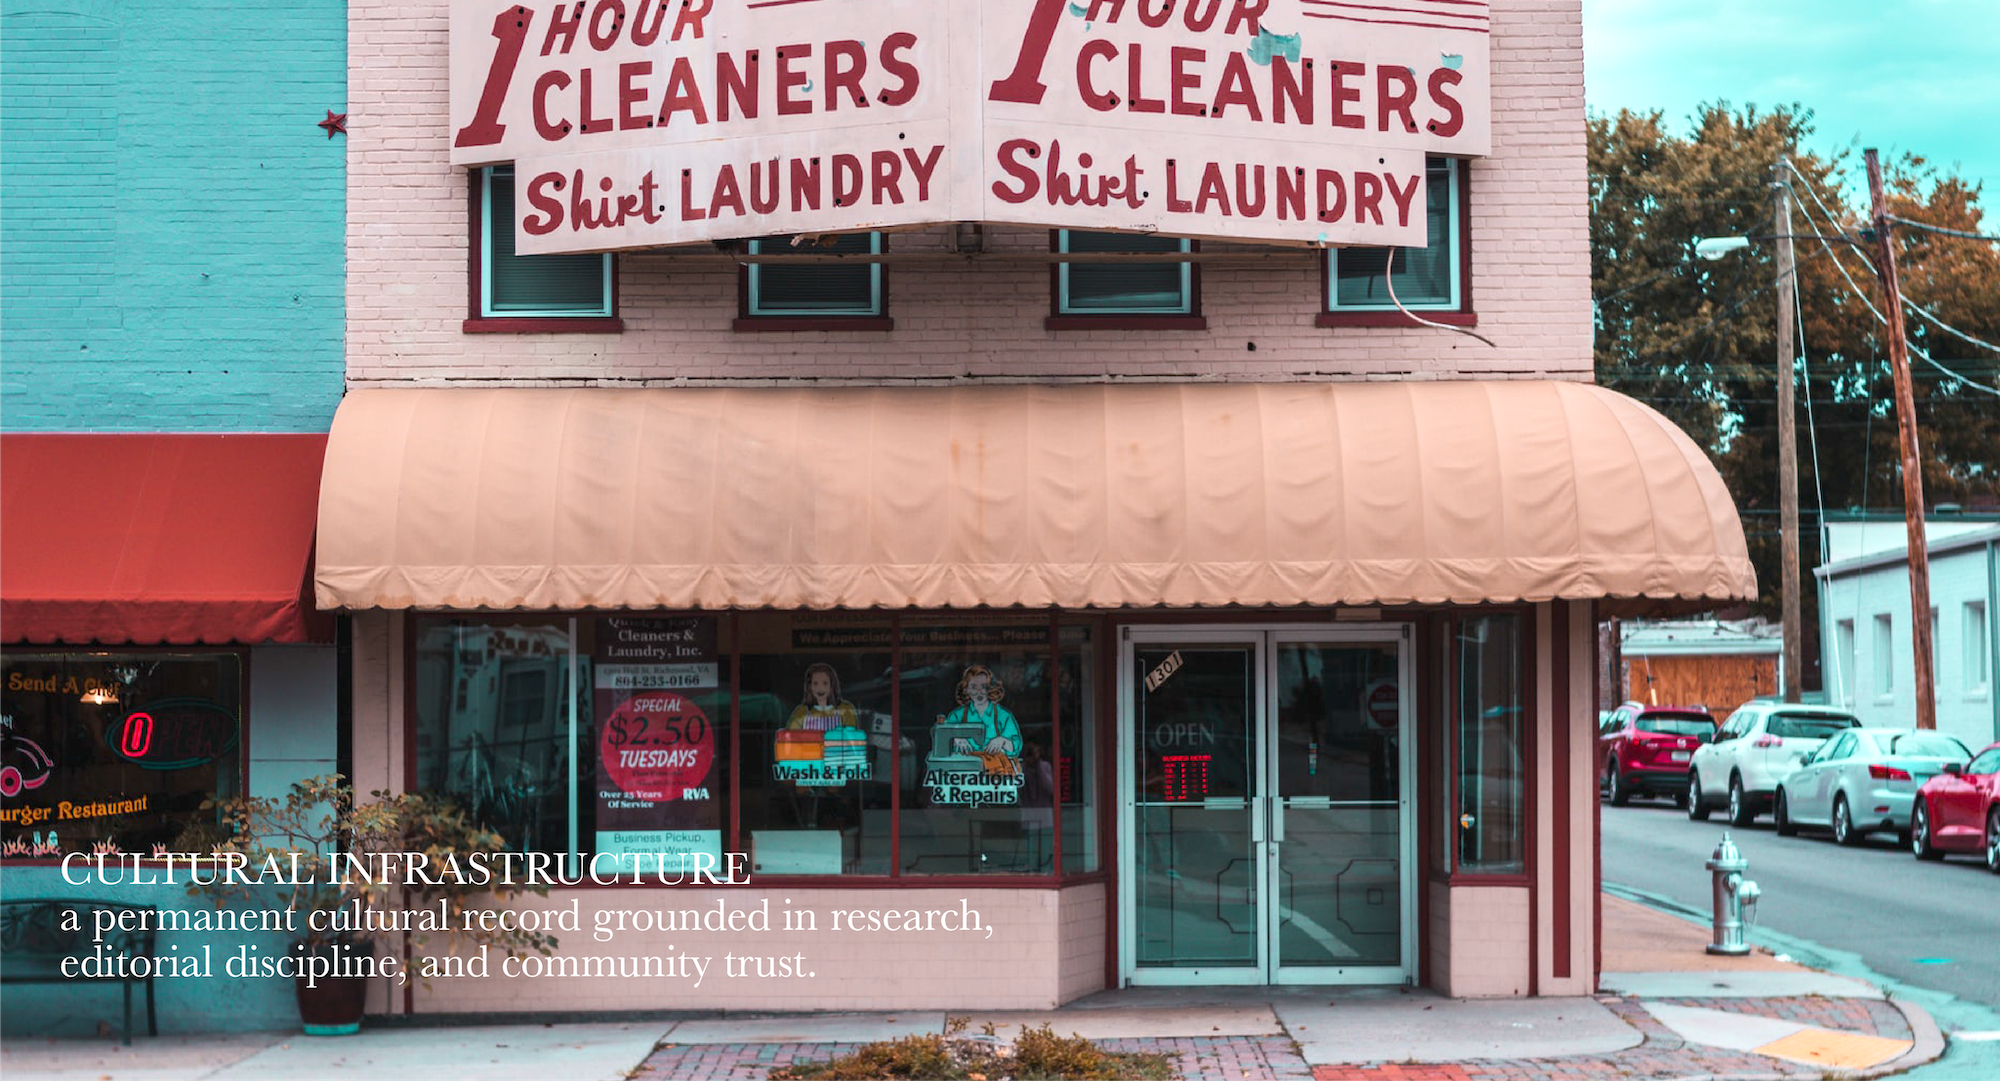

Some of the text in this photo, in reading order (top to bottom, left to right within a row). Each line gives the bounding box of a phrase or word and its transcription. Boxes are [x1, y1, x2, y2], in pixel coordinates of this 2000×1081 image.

[988, 0, 1066, 104] 1
[454, 0, 712, 147] 1 HOUR
[533, 32, 919, 141] CLEANERS
[1076, 39, 1464, 138] CLEANERS
[523, 145, 945, 235] Shirt LAUNDRY
[992, 139, 1420, 227] Shirt LAUNDRY
[618, 629, 695, 642] Cleaners &
[799, 631, 820, 643] We
[900, 630, 926, 642] Your
[1002, 629, 1046, 642] Please
[608, 645, 702, 659] Laundry, Inc.
[697, 665, 710, 673] VA
[1147, 653, 1181, 688] 1301
[8, 671, 121, 698] Send A Chef
[615, 675, 700, 687] 804-233-0166
[633, 698, 682, 712] SPECIAL
[608, 713, 705, 750] $2.50
[1155, 722, 1215, 747] OPEN
[620, 749, 698, 768] TUESDAYS
[774, 763, 871, 779] Wash & Fold
[924, 768, 1023, 786] Alterations
[600, 790, 622, 798] Over
[636, 789, 662, 799] Years
[682, 788, 710, 800] RVA
[932, 786, 1015, 807] & Repairs
[0, 794, 148, 825] urger Restaurant
[608, 800, 655, 808] Of Service
[614, 832, 706, 844] Business Pickup,
